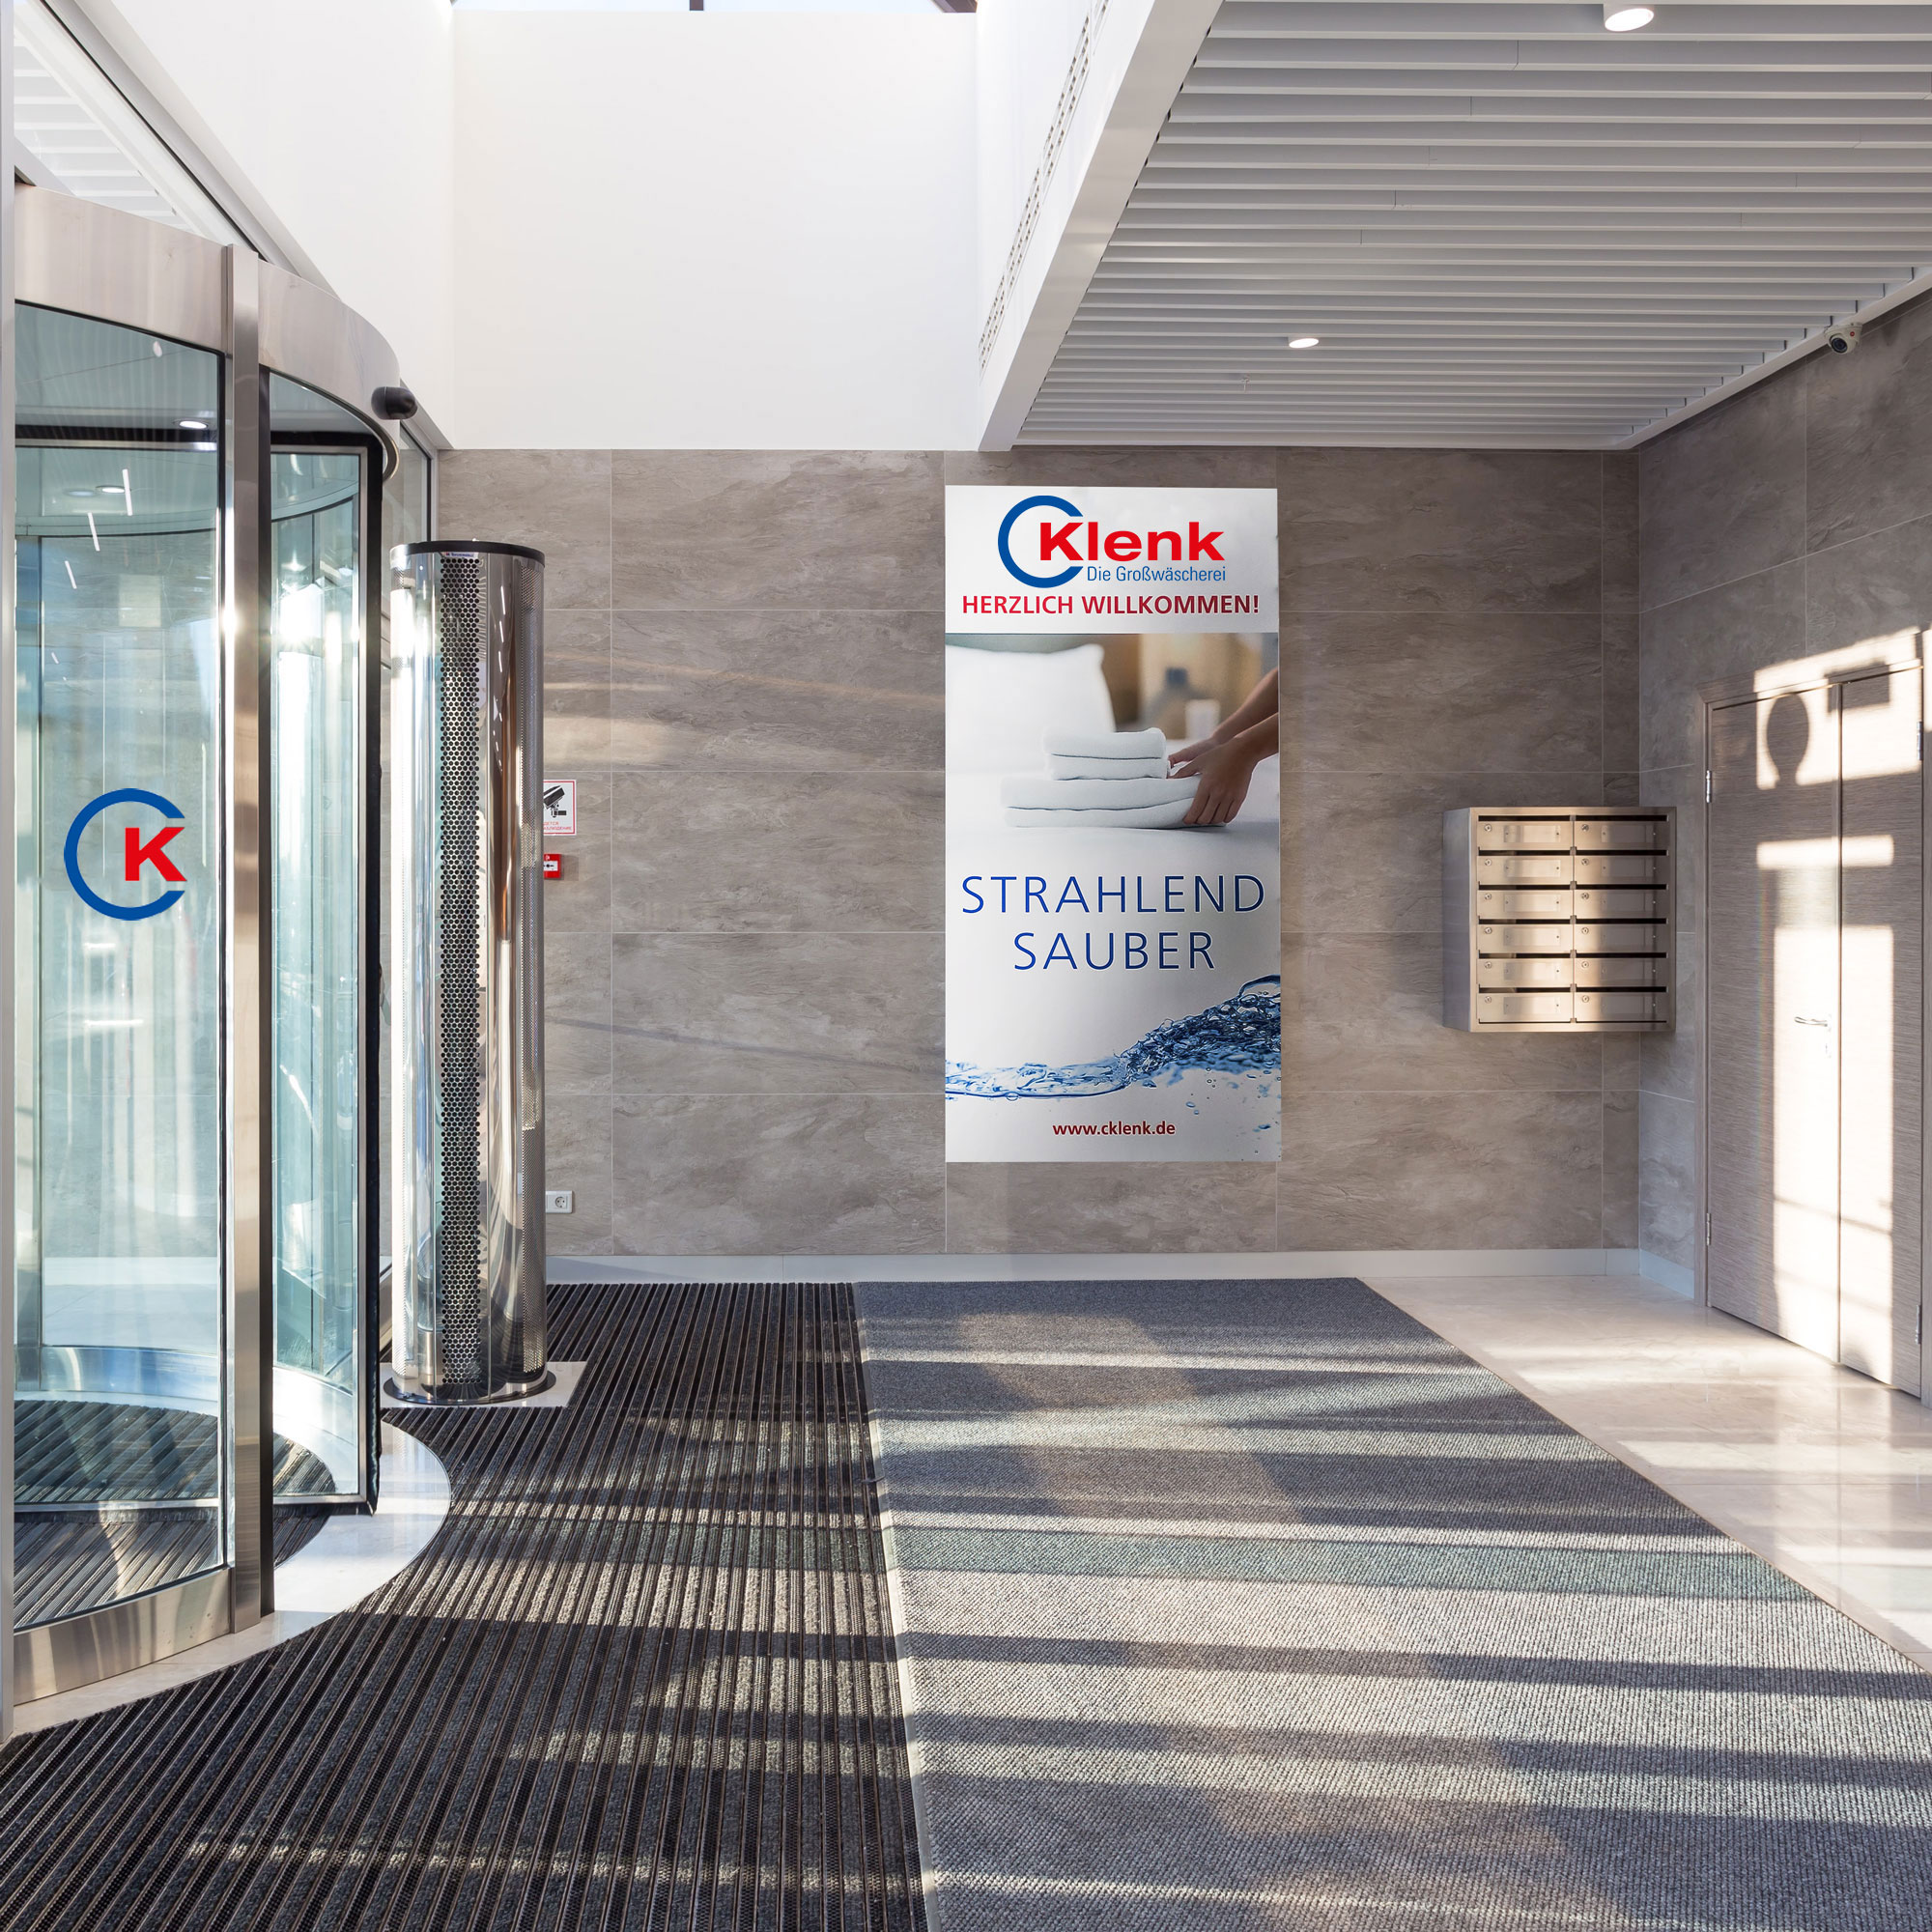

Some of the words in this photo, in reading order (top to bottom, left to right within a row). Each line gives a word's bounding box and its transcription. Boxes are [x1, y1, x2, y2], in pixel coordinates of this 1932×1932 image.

[1087, 565, 1111, 582] Die
[1116, 565, 1226, 582] Großwäscherei
[962, 595, 1073, 614] HERZLICH
[1082, 595, 1259, 614] WILLKOMMEN!
[961, 874, 1264, 914] STRAHLEND
[1013, 931, 1215, 971] SAUBER
[1052, 1121, 1177, 1136] www.cklenk.de
